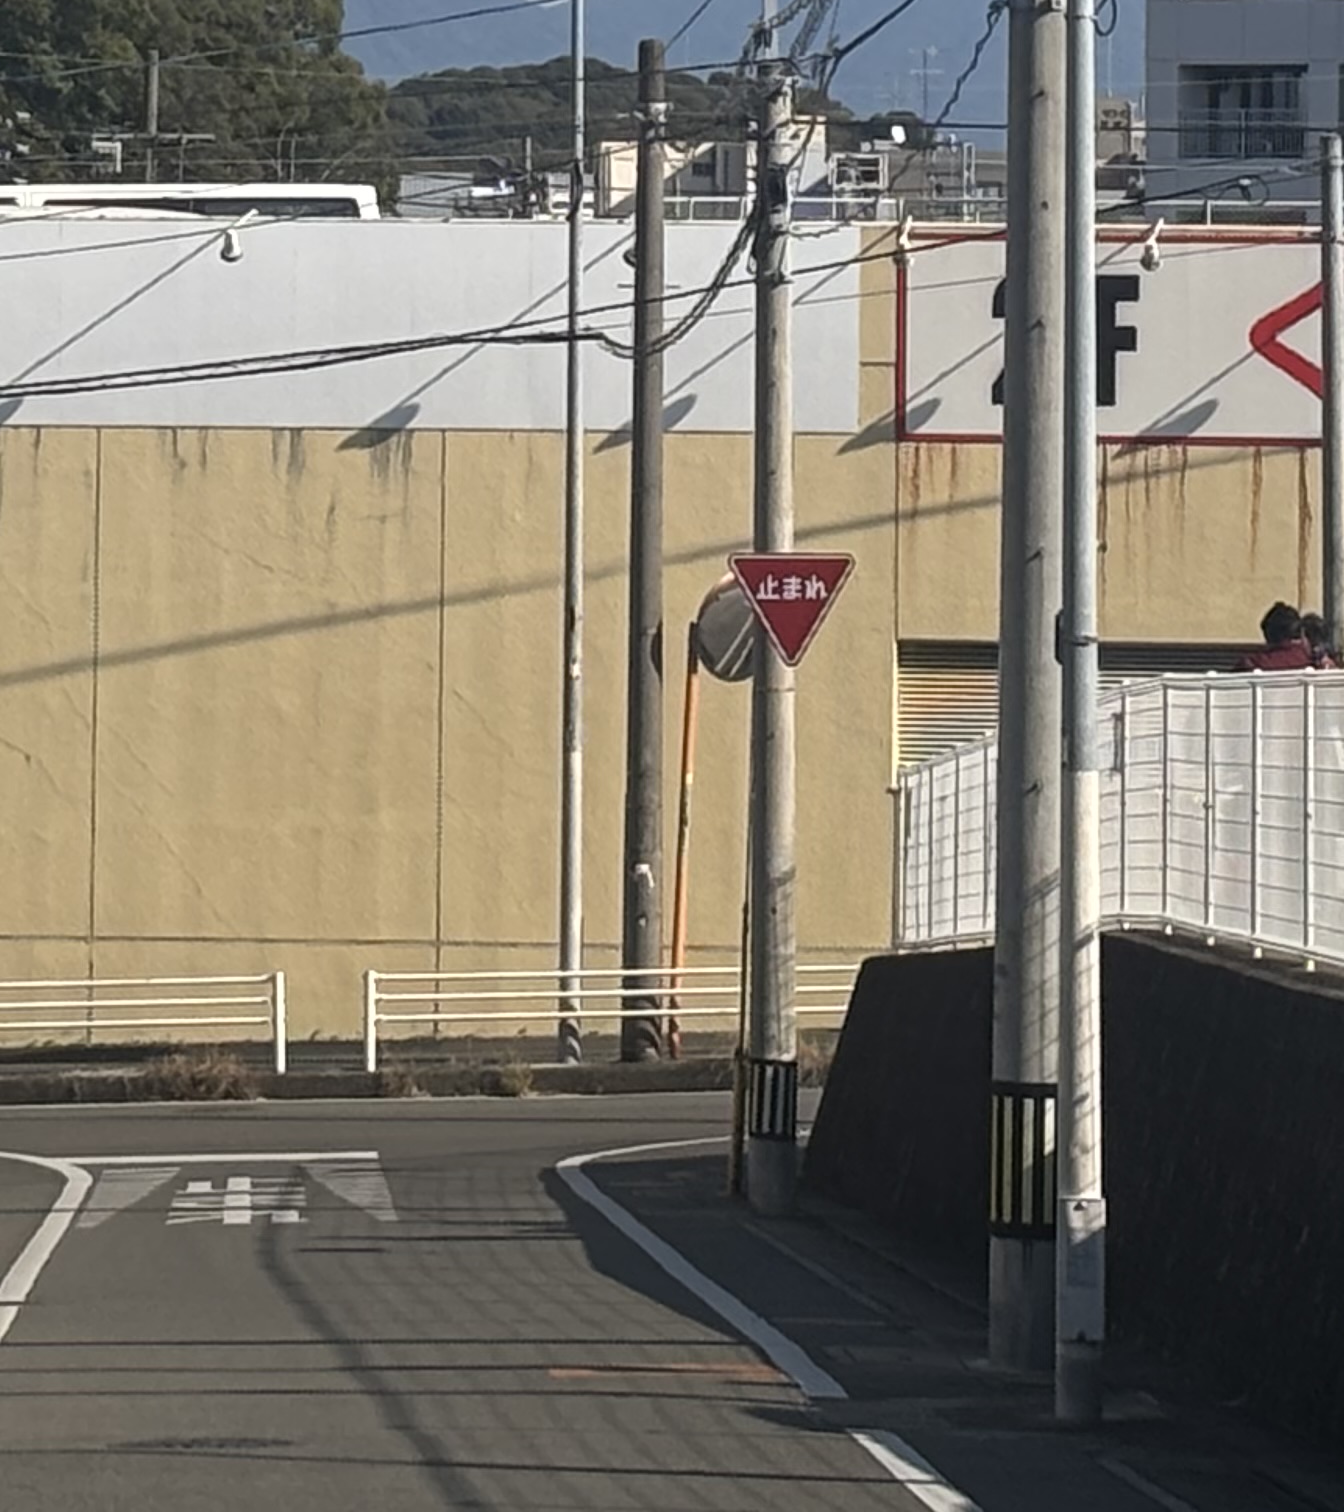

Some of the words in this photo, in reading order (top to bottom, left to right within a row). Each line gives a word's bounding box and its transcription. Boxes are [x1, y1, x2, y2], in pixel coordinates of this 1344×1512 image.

[992, 274, 1140, 407] F
[756, 573, 828, 601] 止まれ
